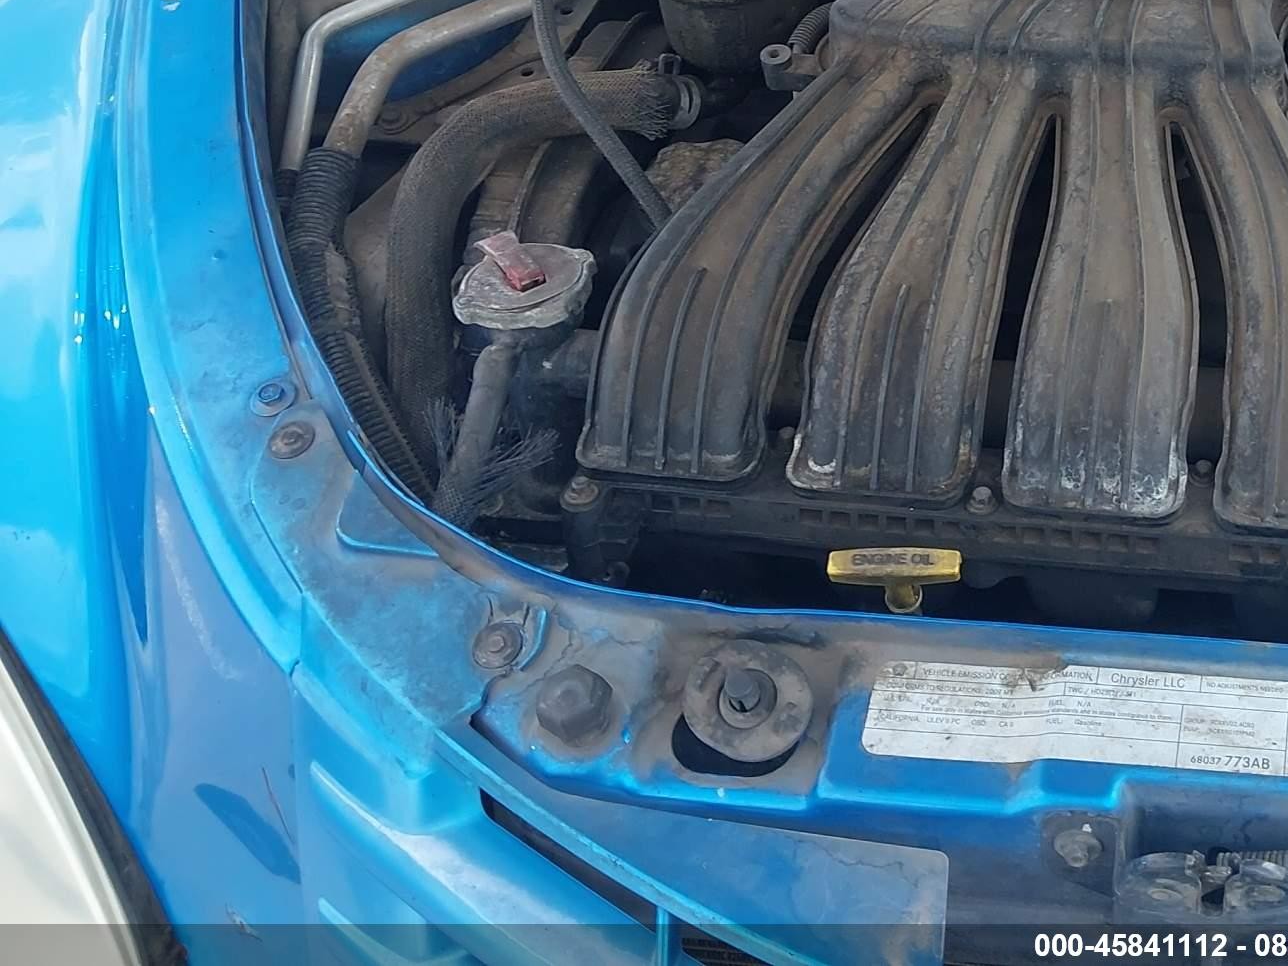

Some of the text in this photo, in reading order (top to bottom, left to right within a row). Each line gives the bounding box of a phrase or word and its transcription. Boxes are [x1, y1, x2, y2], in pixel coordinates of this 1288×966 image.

[851, 553, 935, 566] ENGINE OIL
[922, 667, 956, 677] VEHICLE
[957, 669, 997, 679] EMISSION
[1111, 672, 1186, 689] Chrysler LLC
[1078, 700, 1092, 708] N/A
[1190, 755, 1271, 770] 68037 773AB
